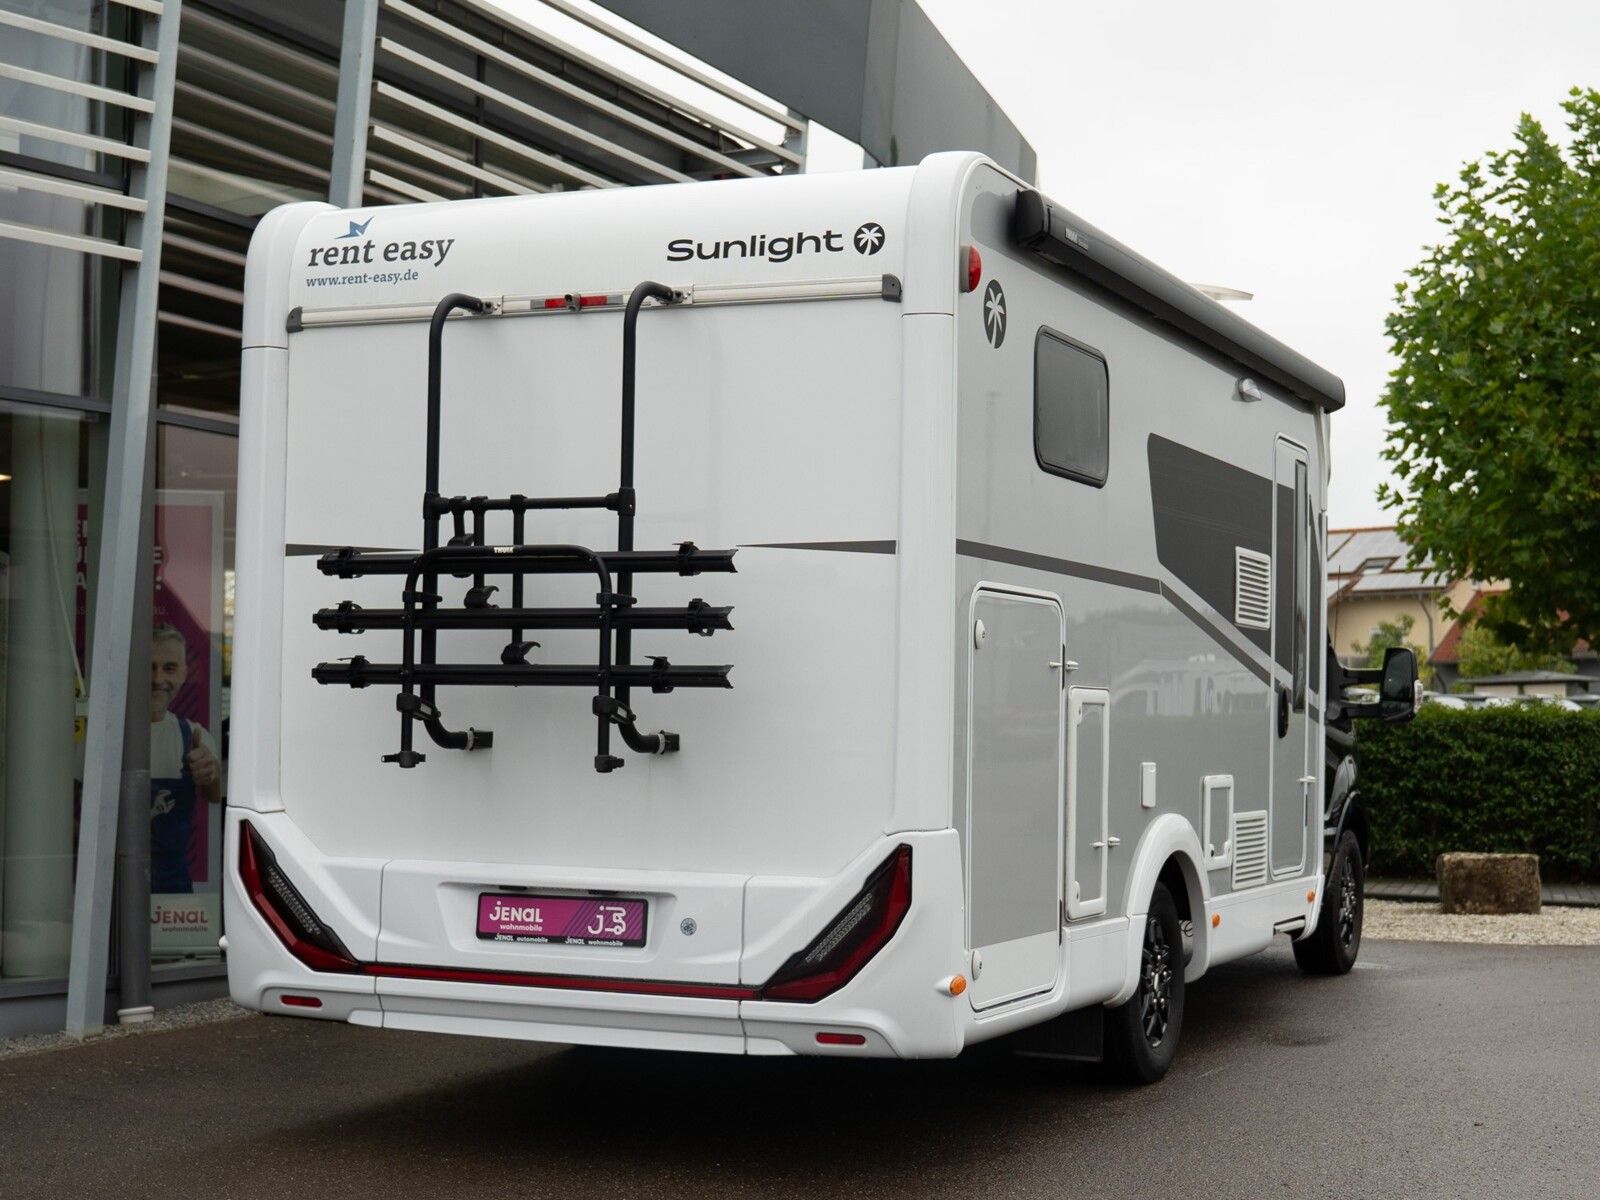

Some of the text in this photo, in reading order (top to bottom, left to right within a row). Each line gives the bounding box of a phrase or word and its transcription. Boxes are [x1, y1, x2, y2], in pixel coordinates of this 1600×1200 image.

[307, 238, 455, 268] rent easy
[666, 230, 844, 263] Sunlight
[306, 269, 419, 287] www.rent-easy.de
[500, 923, 543, 932] wohnmobile
